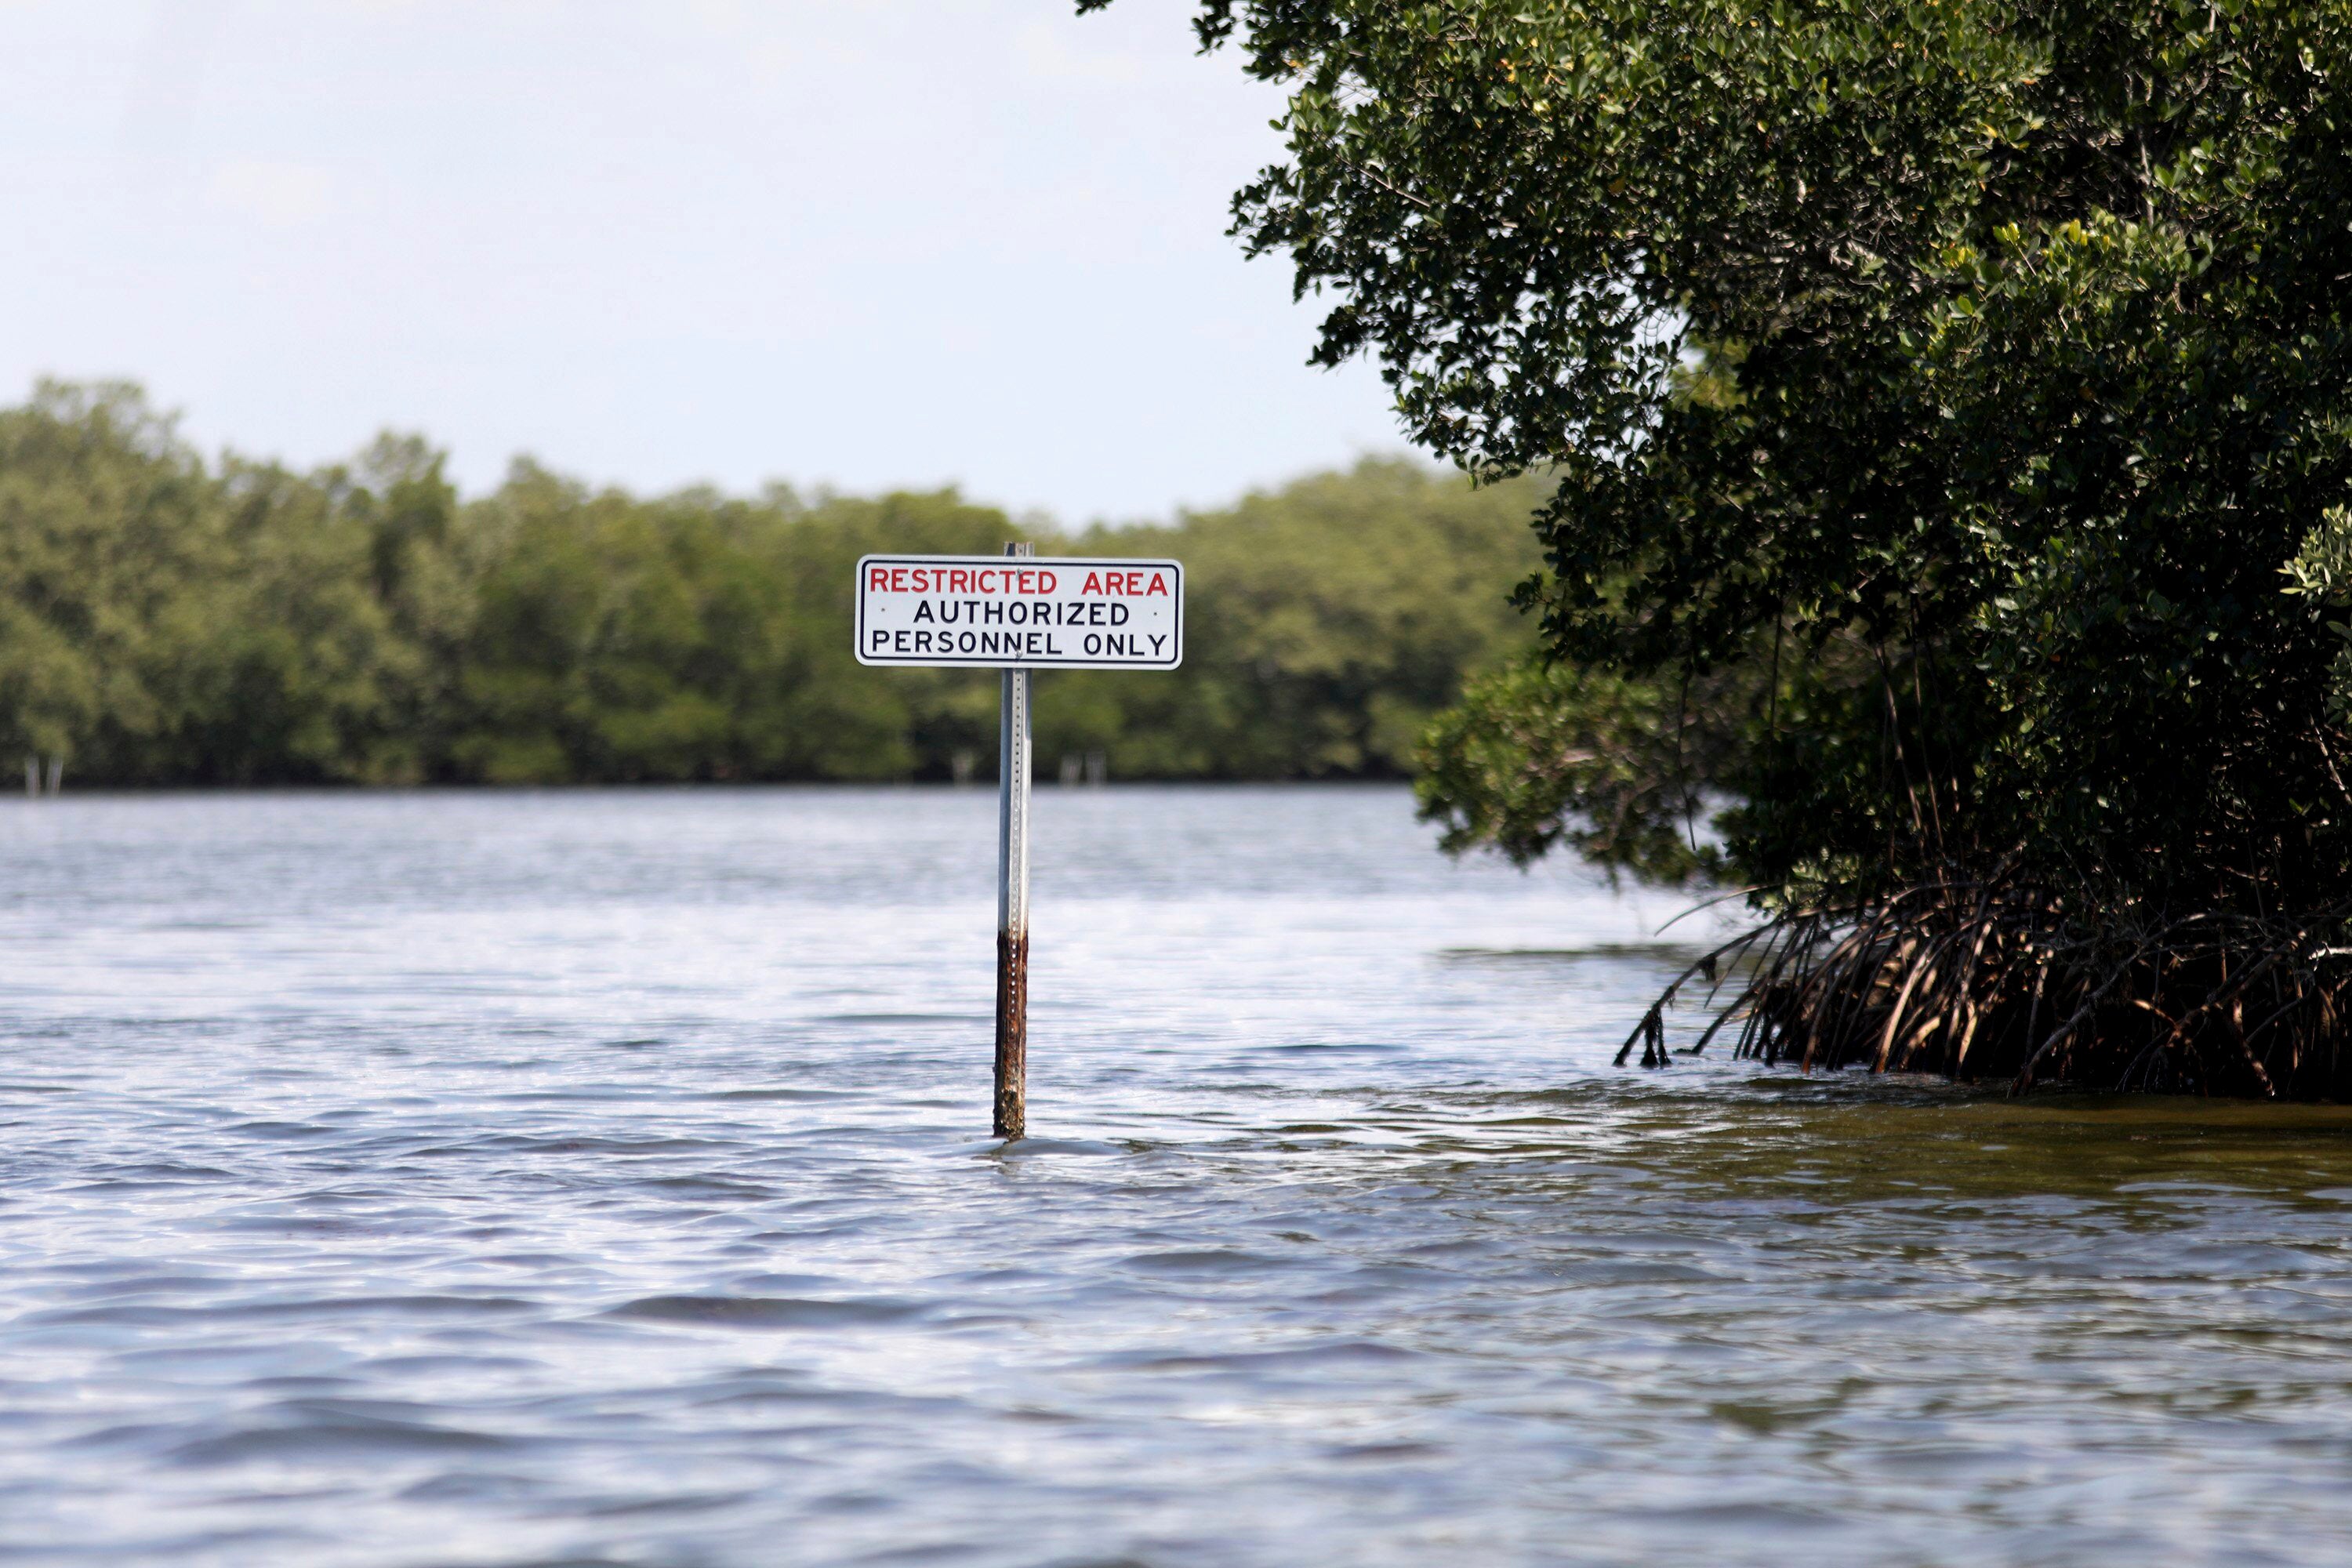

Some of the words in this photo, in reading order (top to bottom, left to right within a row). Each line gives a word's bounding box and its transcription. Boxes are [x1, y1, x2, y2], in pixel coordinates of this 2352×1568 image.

[870, 568, 1057, 594] RESTRICTED
[1082, 572, 1168, 597] AREA
[913, 601, 1130, 626] AUTHORIZED
[873, 630, 1062, 655] PERSONNEL
[1083, 633, 1167, 656] ONLY
